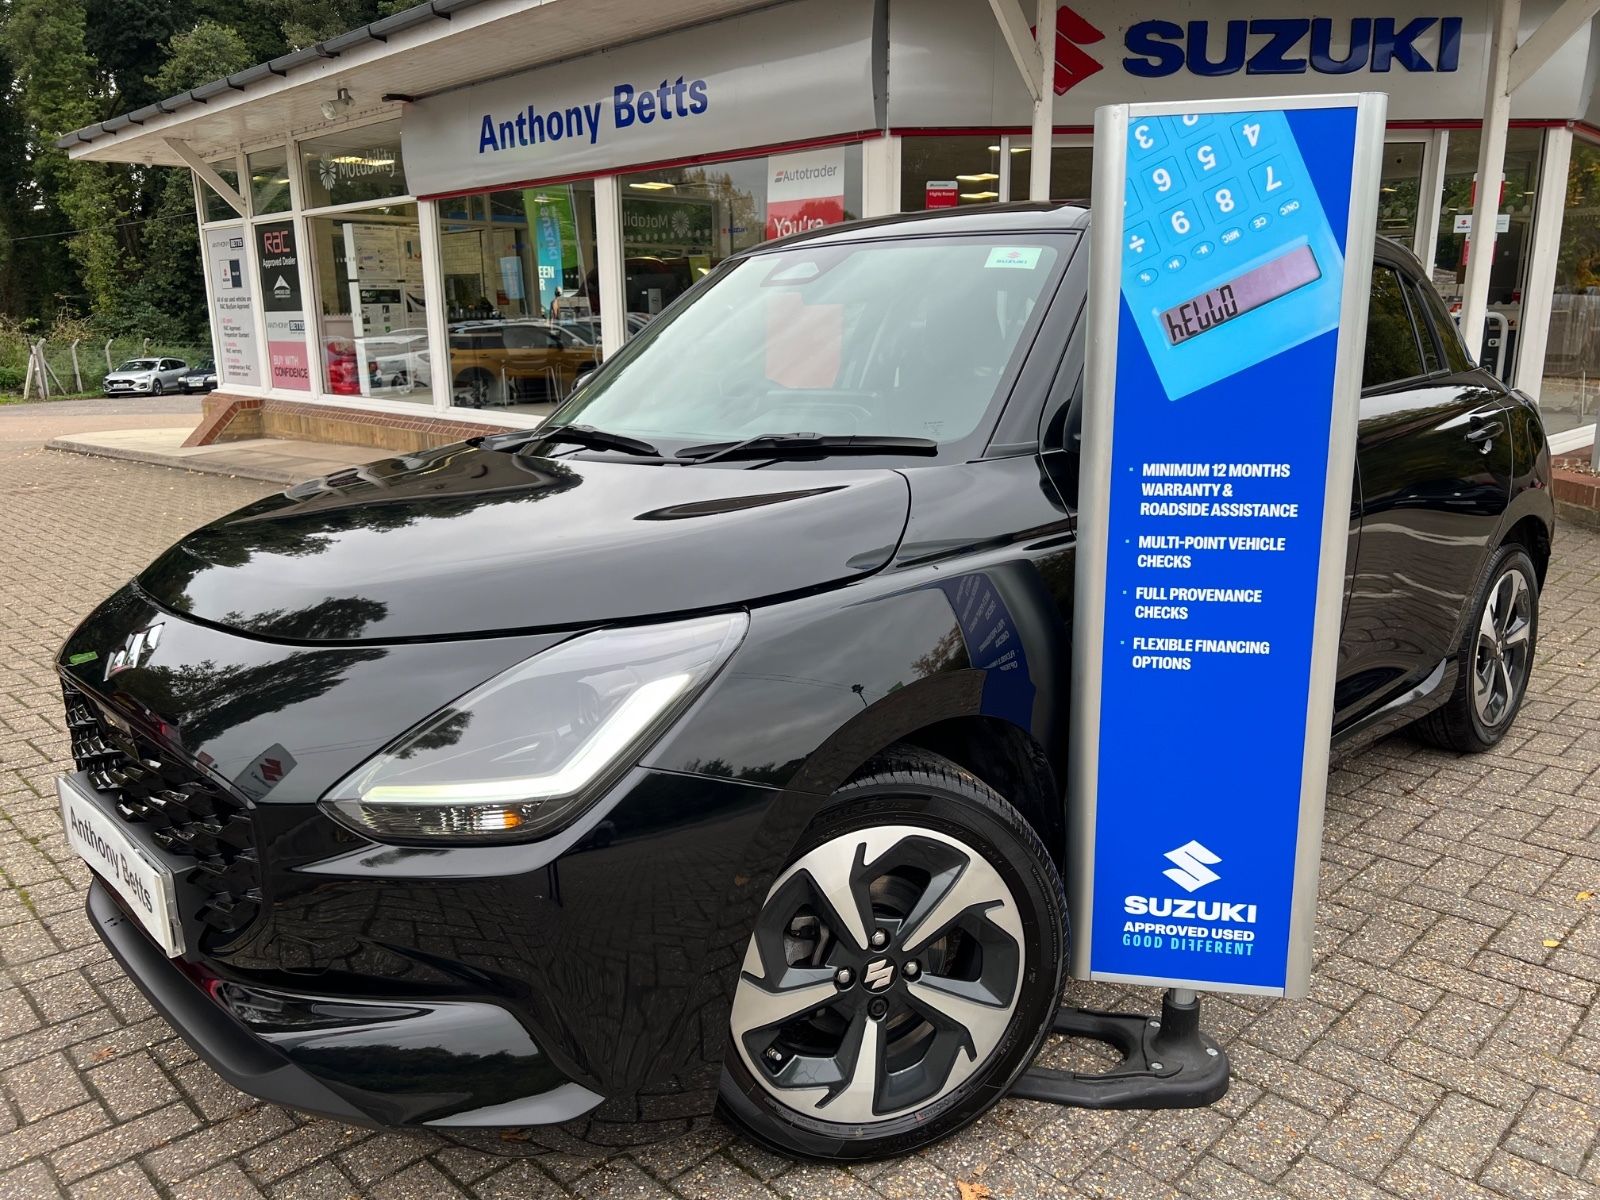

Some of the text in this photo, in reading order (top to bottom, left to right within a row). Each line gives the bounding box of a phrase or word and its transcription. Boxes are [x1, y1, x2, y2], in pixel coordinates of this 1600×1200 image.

[1122, 17, 1462, 77] SUZUKI
[479, 75, 708, 153] Anthony Betts
[1135, 125, 1153, 149] 3
[1243, 123, 1260, 147] 4
[339, 148, 395, 179] Motability
[1197, 145, 1216, 171] 5
[783, 164, 837, 183] Autotrader
[1266, 166, 1282, 192] 7
[1215, 188, 1235, 213] 8
[263, 256, 297, 269] Approved Dealer
[274, 366, 309, 379] CONFIDENCE
[1142, 463, 1291, 478] MINIMUM 12 MONTHS
[1141, 483, 1233, 497] WARRANTY &
[1140, 503, 1298, 517] ROADSIDE ASSISTANCE
[1138, 535, 1286, 551] MULTI-POINT VEHICLE
[1137, 555, 1191, 569] CHECKS
[1136, 587, 1262, 603] FULL PROVENANCE
[1134, 605, 1188, 619] CHECKS
[1133, 637, 1270, 654] FLEXIBLE FINANCING
[1132, 656, 1191, 670] OPTIONS
[70, 806, 153, 913] Anthony Betts
[1123, 895, 1257, 923] SUZUKI
[1123, 921, 1255, 941] APPROVED USED
[1122, 933, 1254, 956] GOOD DIFFERENT
